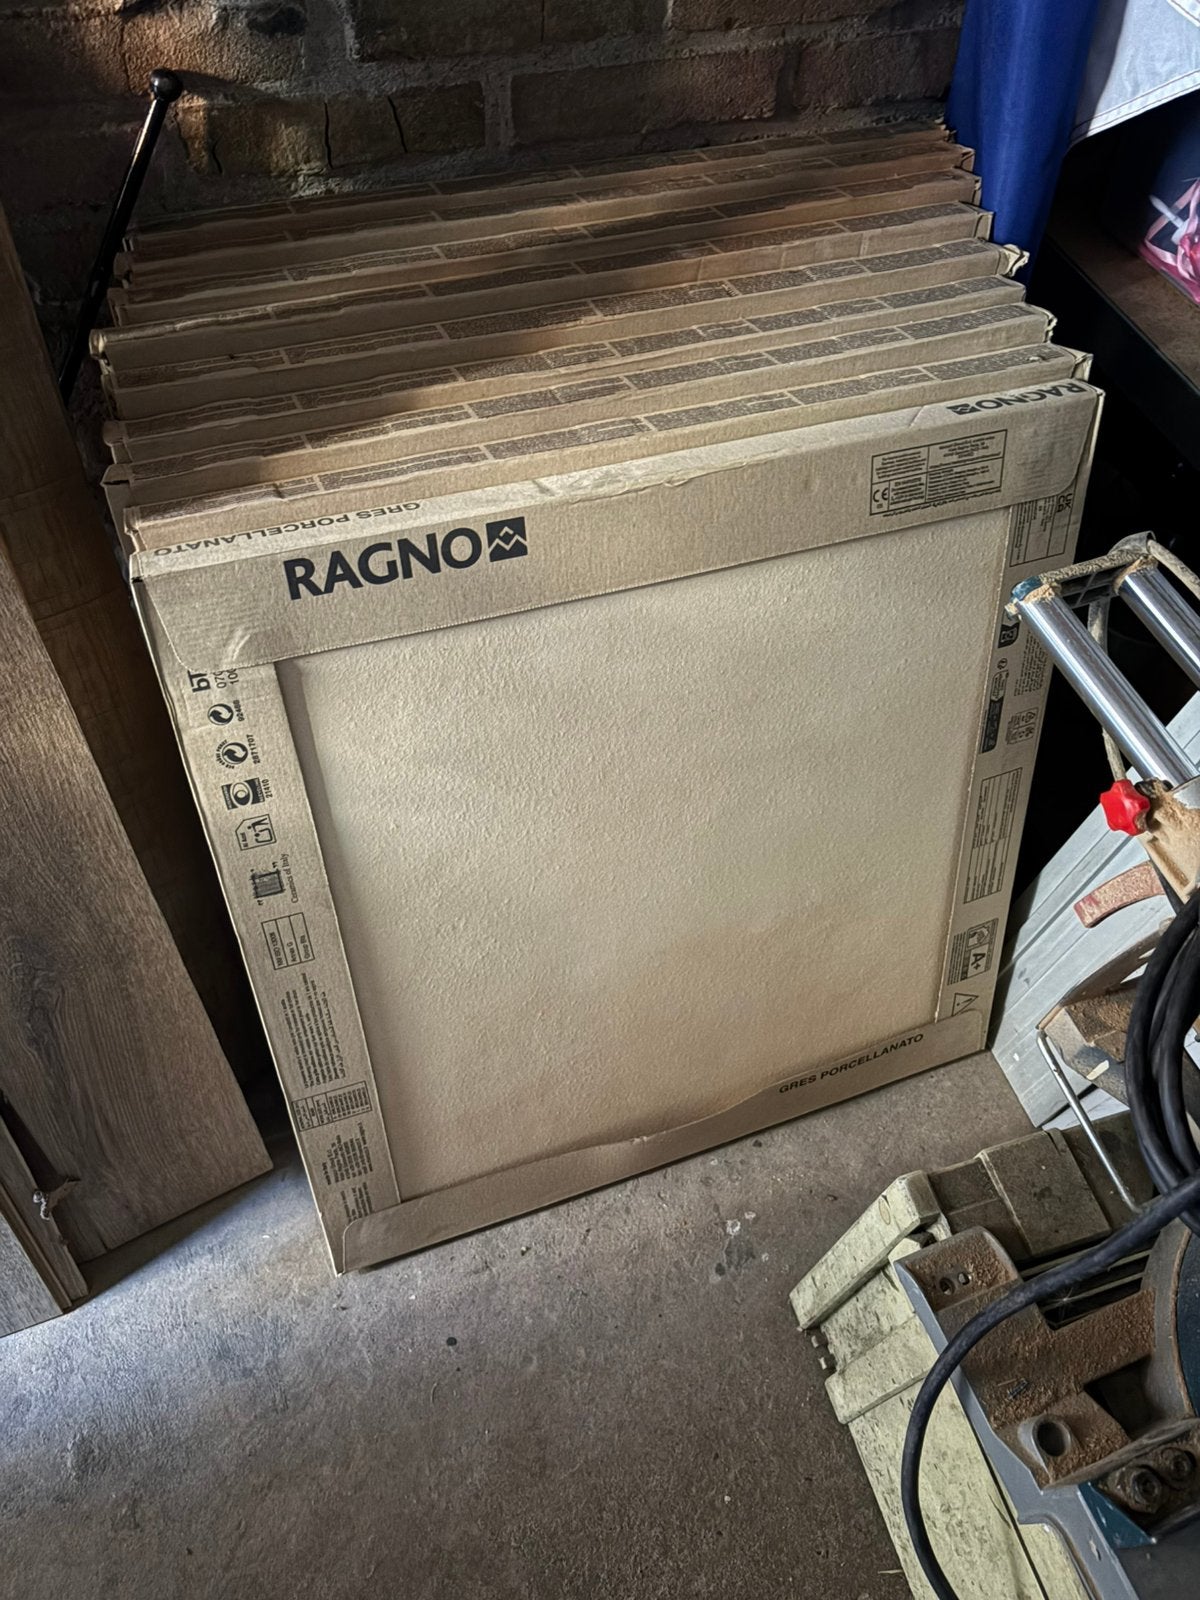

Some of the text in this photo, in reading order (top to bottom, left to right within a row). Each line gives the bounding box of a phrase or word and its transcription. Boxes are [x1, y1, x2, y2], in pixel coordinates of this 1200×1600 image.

[975, 382, 1087, 409] RAGNO
[154, 502, 420, 556] GRES PORCELLANATO
[283, 527, 482, 600] RAGNO
[261, 779, 273, 799] 21410
[280, 852, 290, 868] Italy
[287, 876, 299, 904] Ceramics
[971, 953, 986, 970] A+
[779, 1033, 924, 1094] GRES PORCELLANATO
